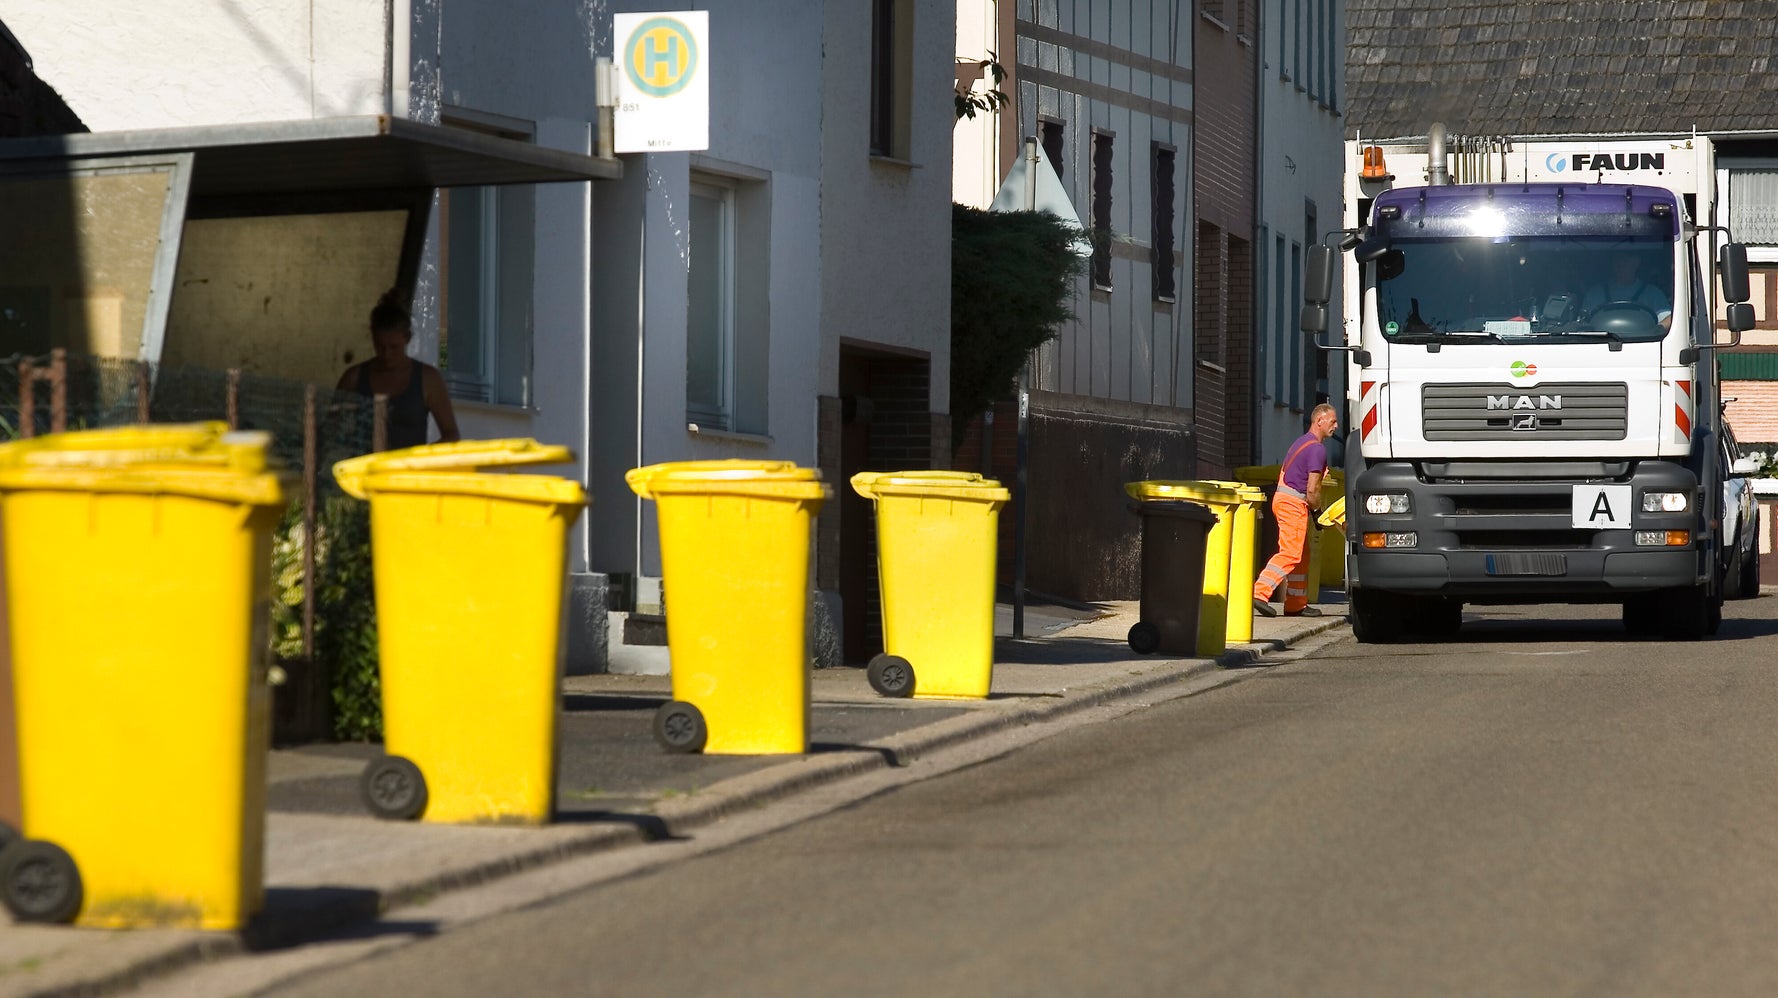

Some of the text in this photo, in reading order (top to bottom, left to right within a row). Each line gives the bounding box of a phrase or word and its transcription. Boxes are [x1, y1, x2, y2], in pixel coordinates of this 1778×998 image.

[1572, 153, 1665, 171] FAUN
[1487, 395, 1562, 410] MAN
[1589, 491, 1615, 522] A
